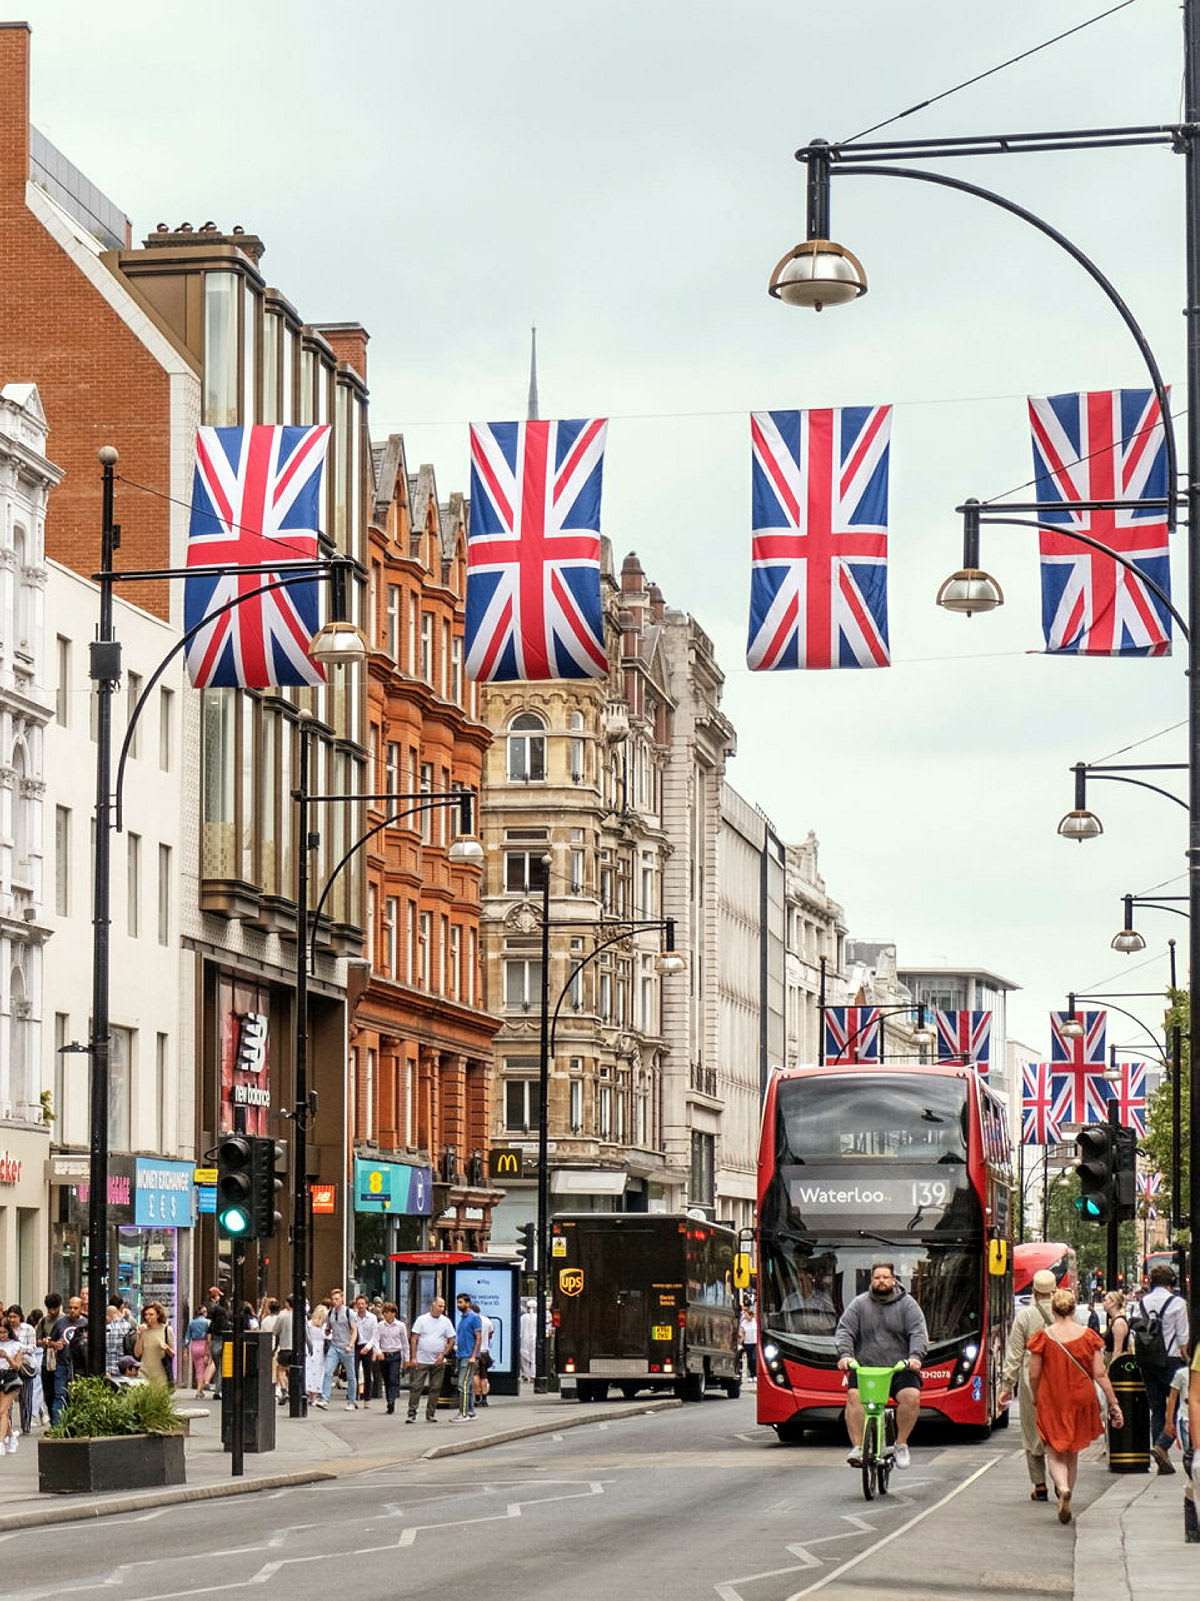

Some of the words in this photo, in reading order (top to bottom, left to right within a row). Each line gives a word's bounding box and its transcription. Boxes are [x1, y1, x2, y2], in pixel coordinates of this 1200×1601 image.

[799, 1186, 884, 1204] Waterloo
[912, 1183, 947, 1207] 139
[561, 1276, 582, 1292] ups
